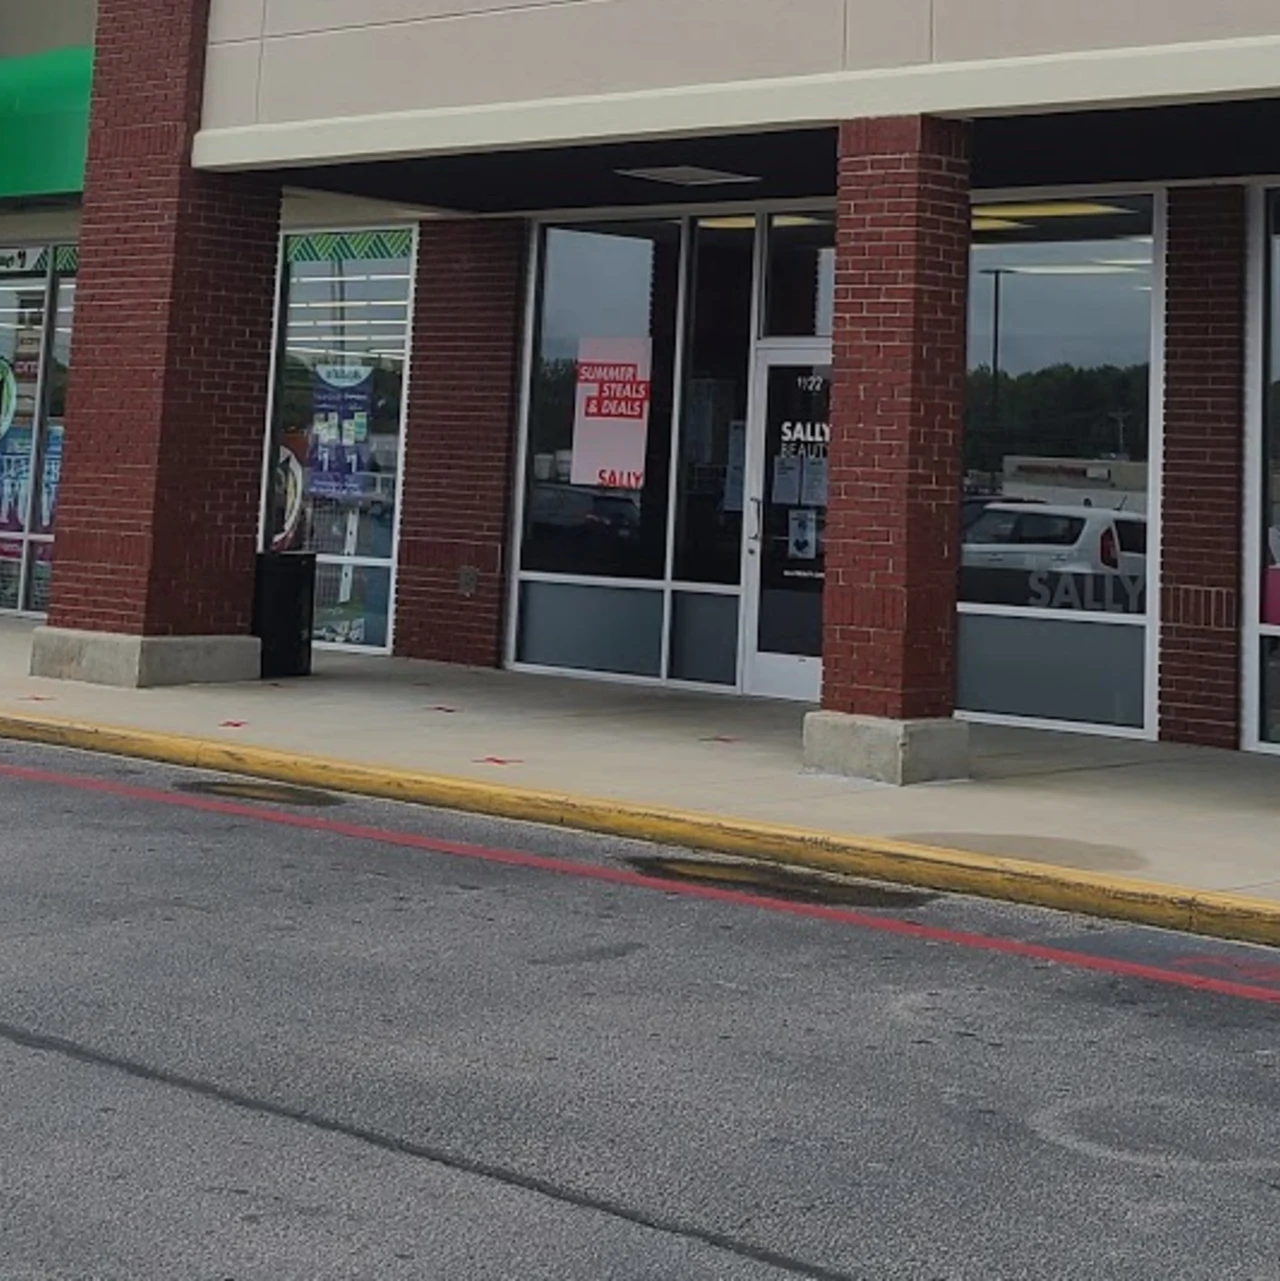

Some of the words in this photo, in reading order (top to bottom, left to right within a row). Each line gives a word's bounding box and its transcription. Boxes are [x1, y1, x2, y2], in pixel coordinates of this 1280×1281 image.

[579, 365, 634, 381] SUMMER
[601, 382, 646, 398] STEALS
[587, 400, 598, 413] &
[601, 400, 641, 416] DEALS
[781, 422, 830, 442] SALLY
[598, 470, 642, 488] SALLY
[1027, 570, 1145, 613] SALLY
